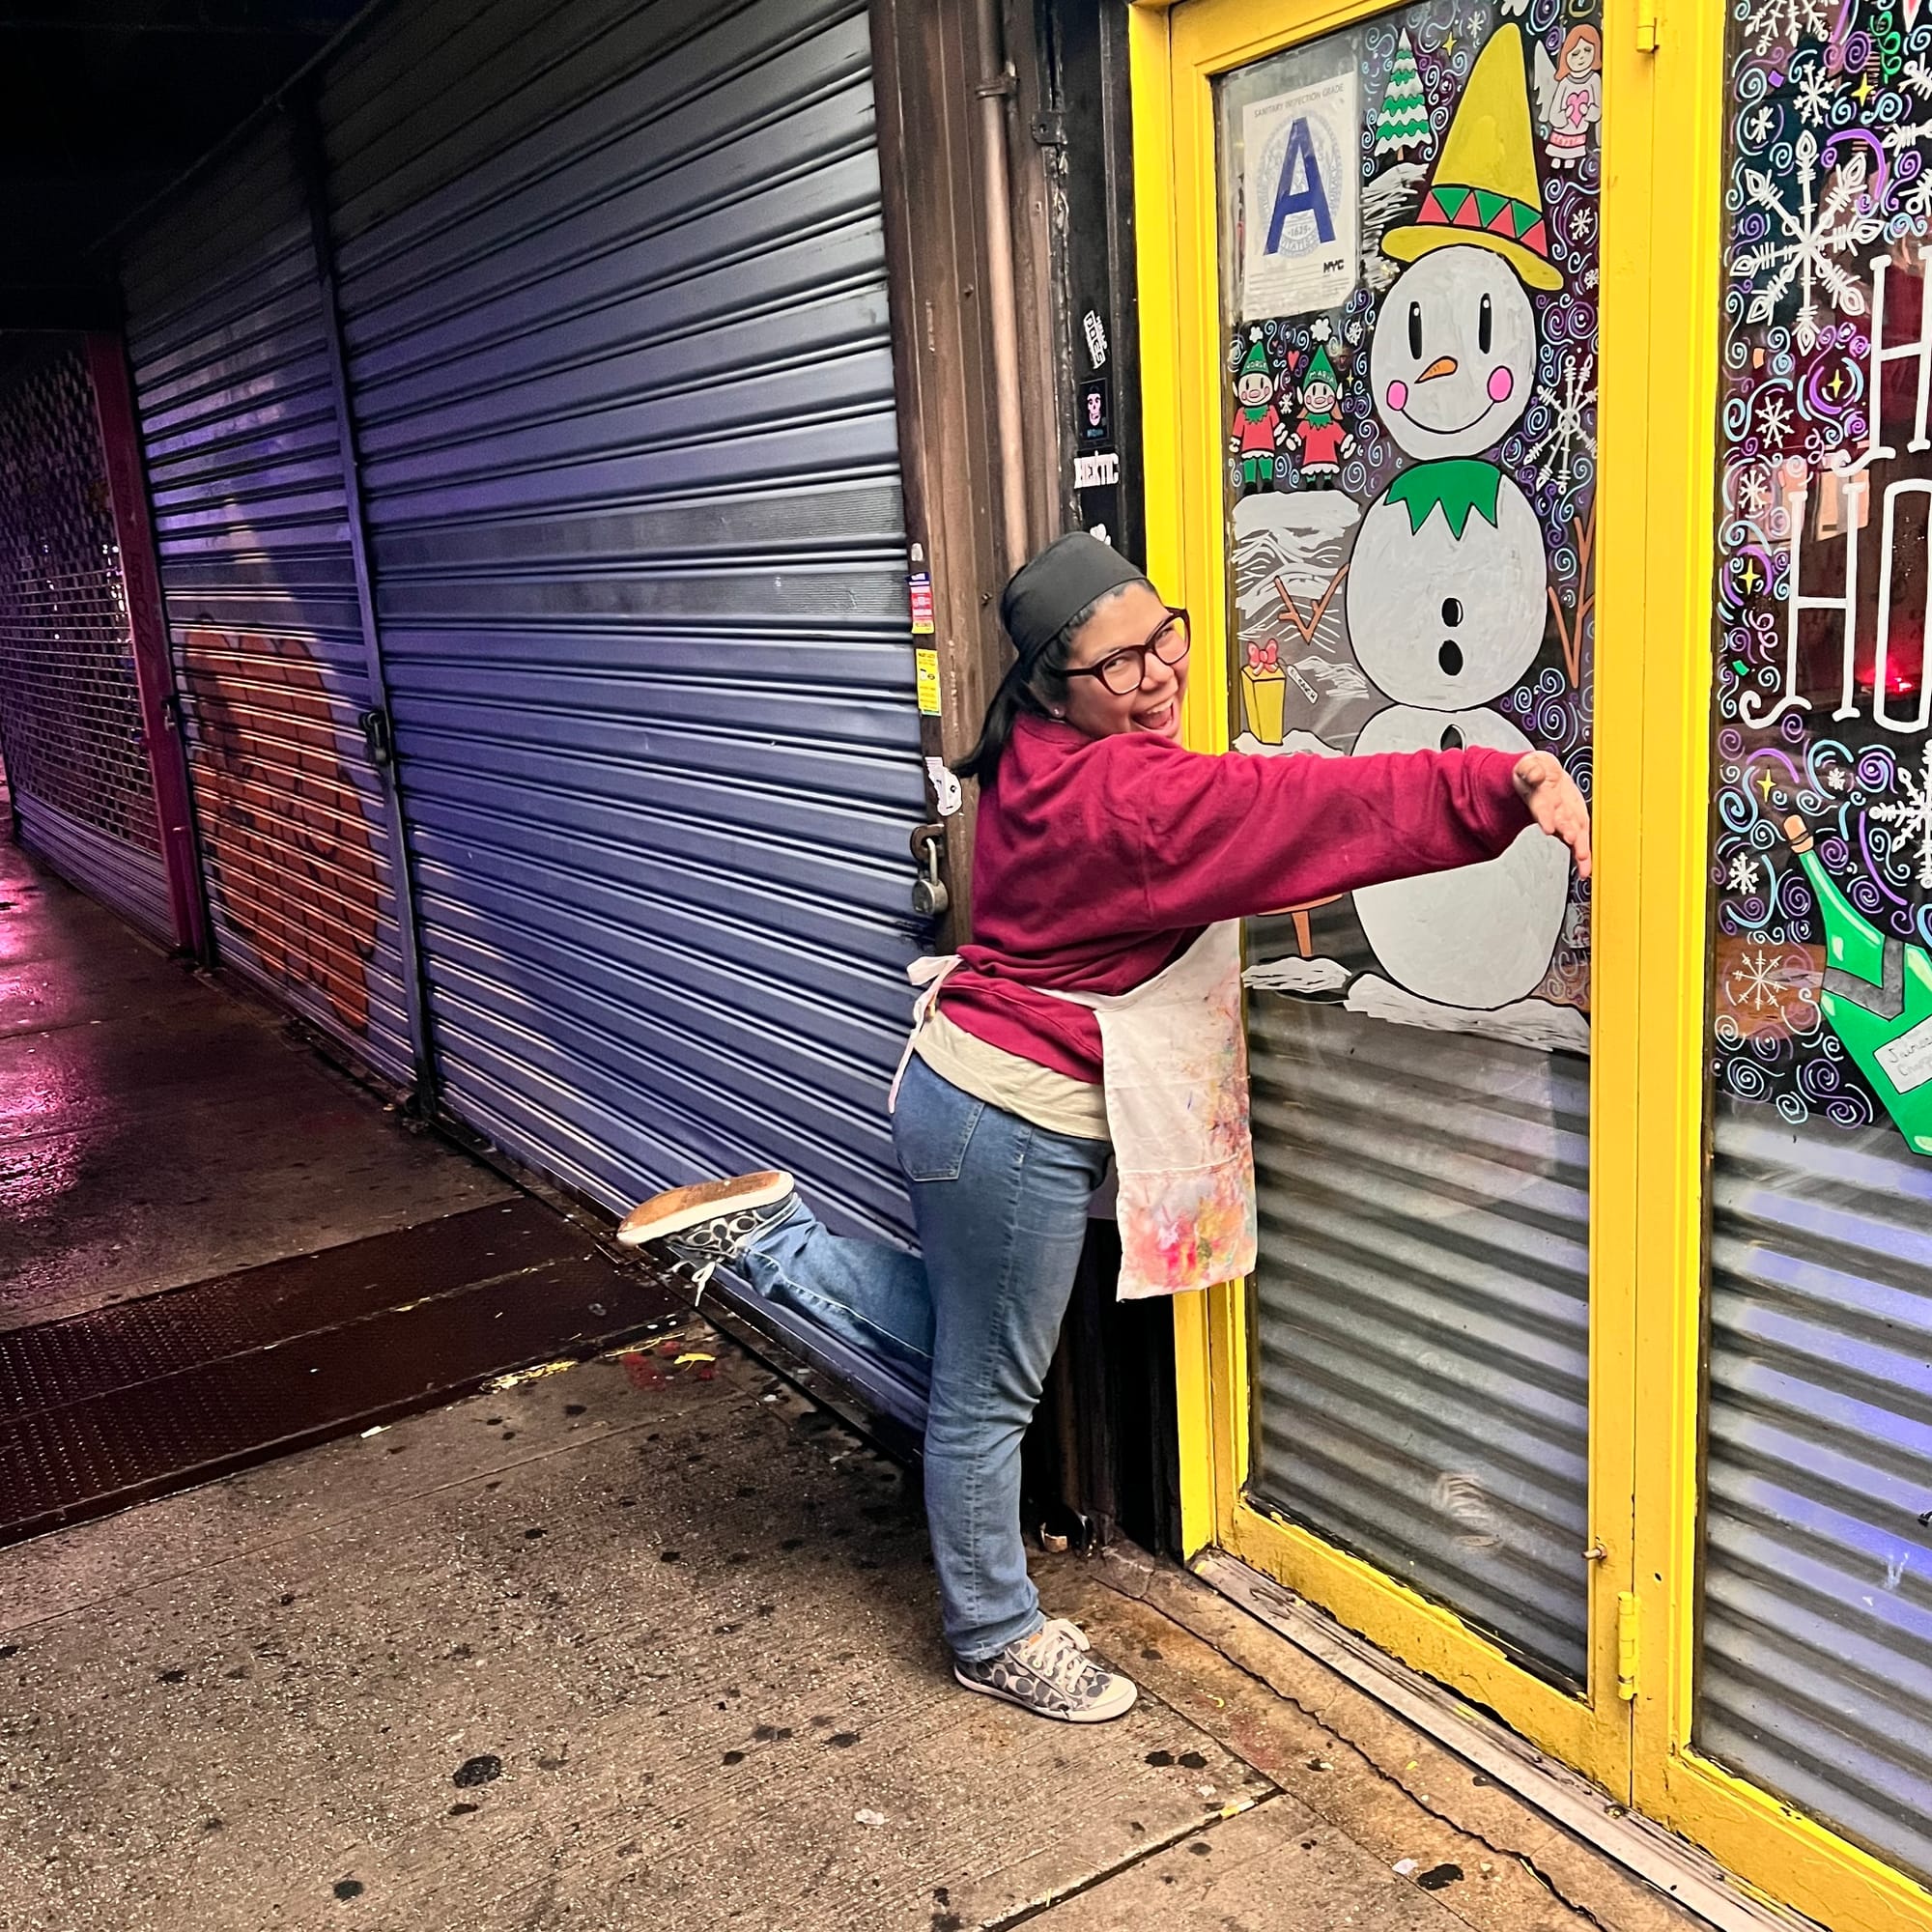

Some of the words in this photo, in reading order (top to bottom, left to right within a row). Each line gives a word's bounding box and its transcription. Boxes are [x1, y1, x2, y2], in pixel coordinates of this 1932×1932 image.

[1254, 102, 1284, 117] SANITARY
[1285, 92, 1321, 108] INSPECTION
[1321, 83, 1344, 97] GRADE
[1263, 116, 1336, 256] A
[1322, 259, 1345, 273] NYC
